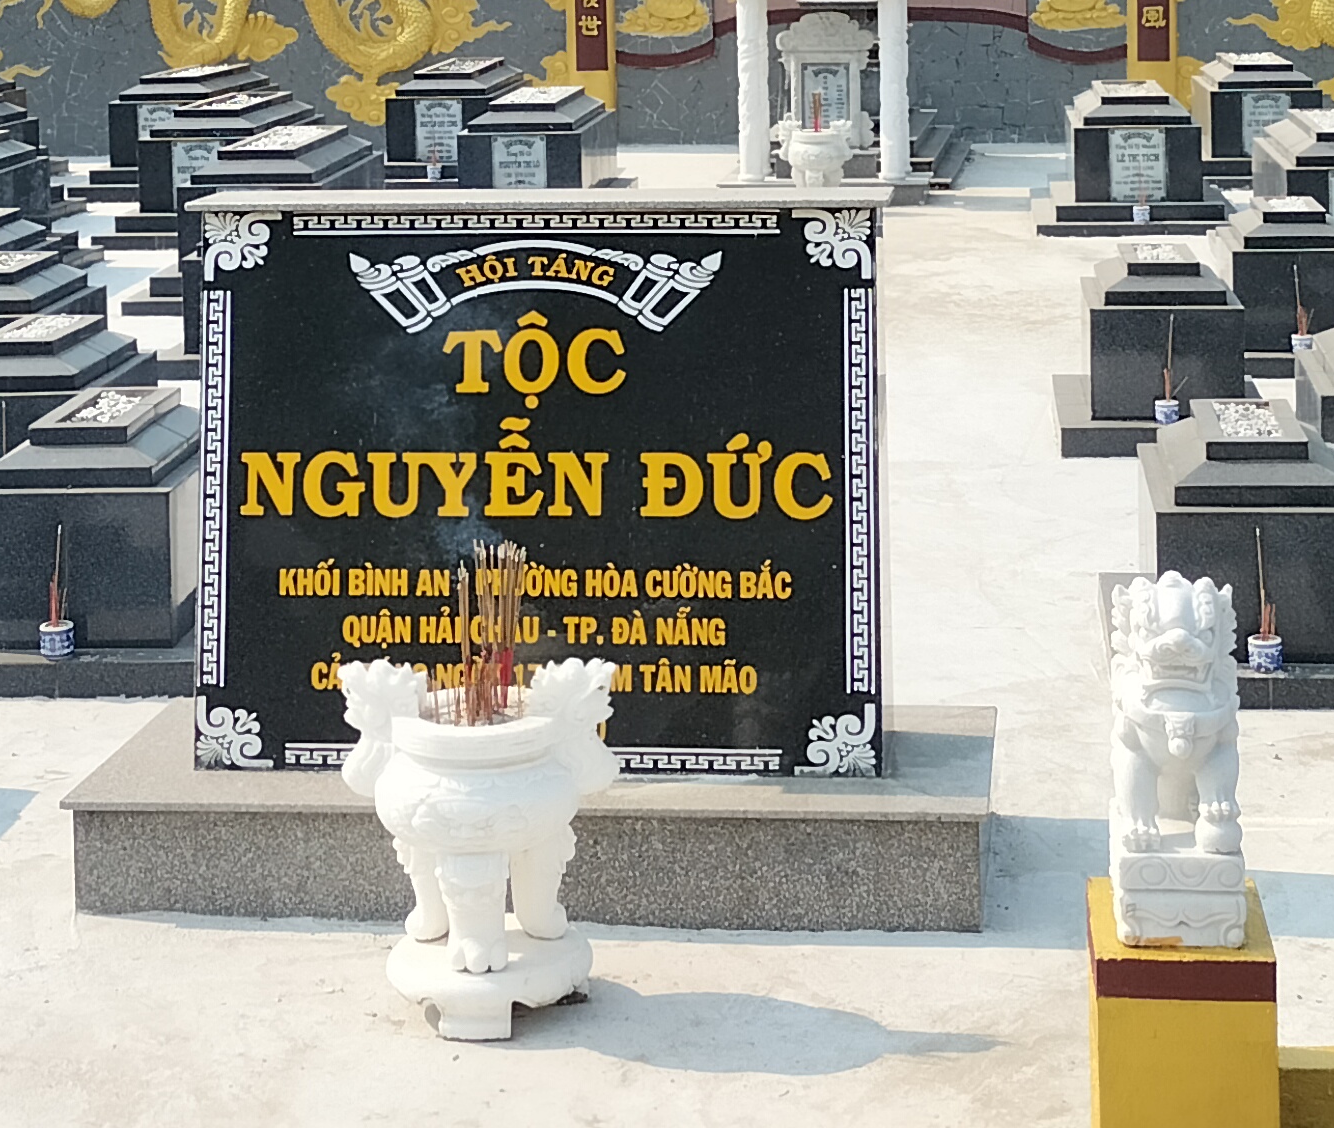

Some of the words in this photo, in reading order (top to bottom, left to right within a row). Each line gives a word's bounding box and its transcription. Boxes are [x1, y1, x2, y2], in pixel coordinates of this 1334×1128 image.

[455, 255, 518, 287] HỘI
[527, 253, 615, 287] TÁNG
[442, 310, 627, 410] TỘC
[240, 416, 609, 519] NGUYỄN
[639, 433, 833, 519] ĐỨC
[279, 559, 341, 597] KHỐI
[348, 562, 409, 597] BÌNH
[415, 568, 451, 597] AN
[585, 562, 639, 598] HÒA
[645, 562, 732, 599] CƯỜNG
[739, 559, 793, 600] BẮC
[342, 608, 412, 649] QUẬN
[562, 616, 605, 647] TP.
[611, 610, 648, 646] ĐÀ
[656, 607, 727, 646] NẴNG
[639, 657, 692, 694] TÂN
[699, 658, 758, 695] MÃO
